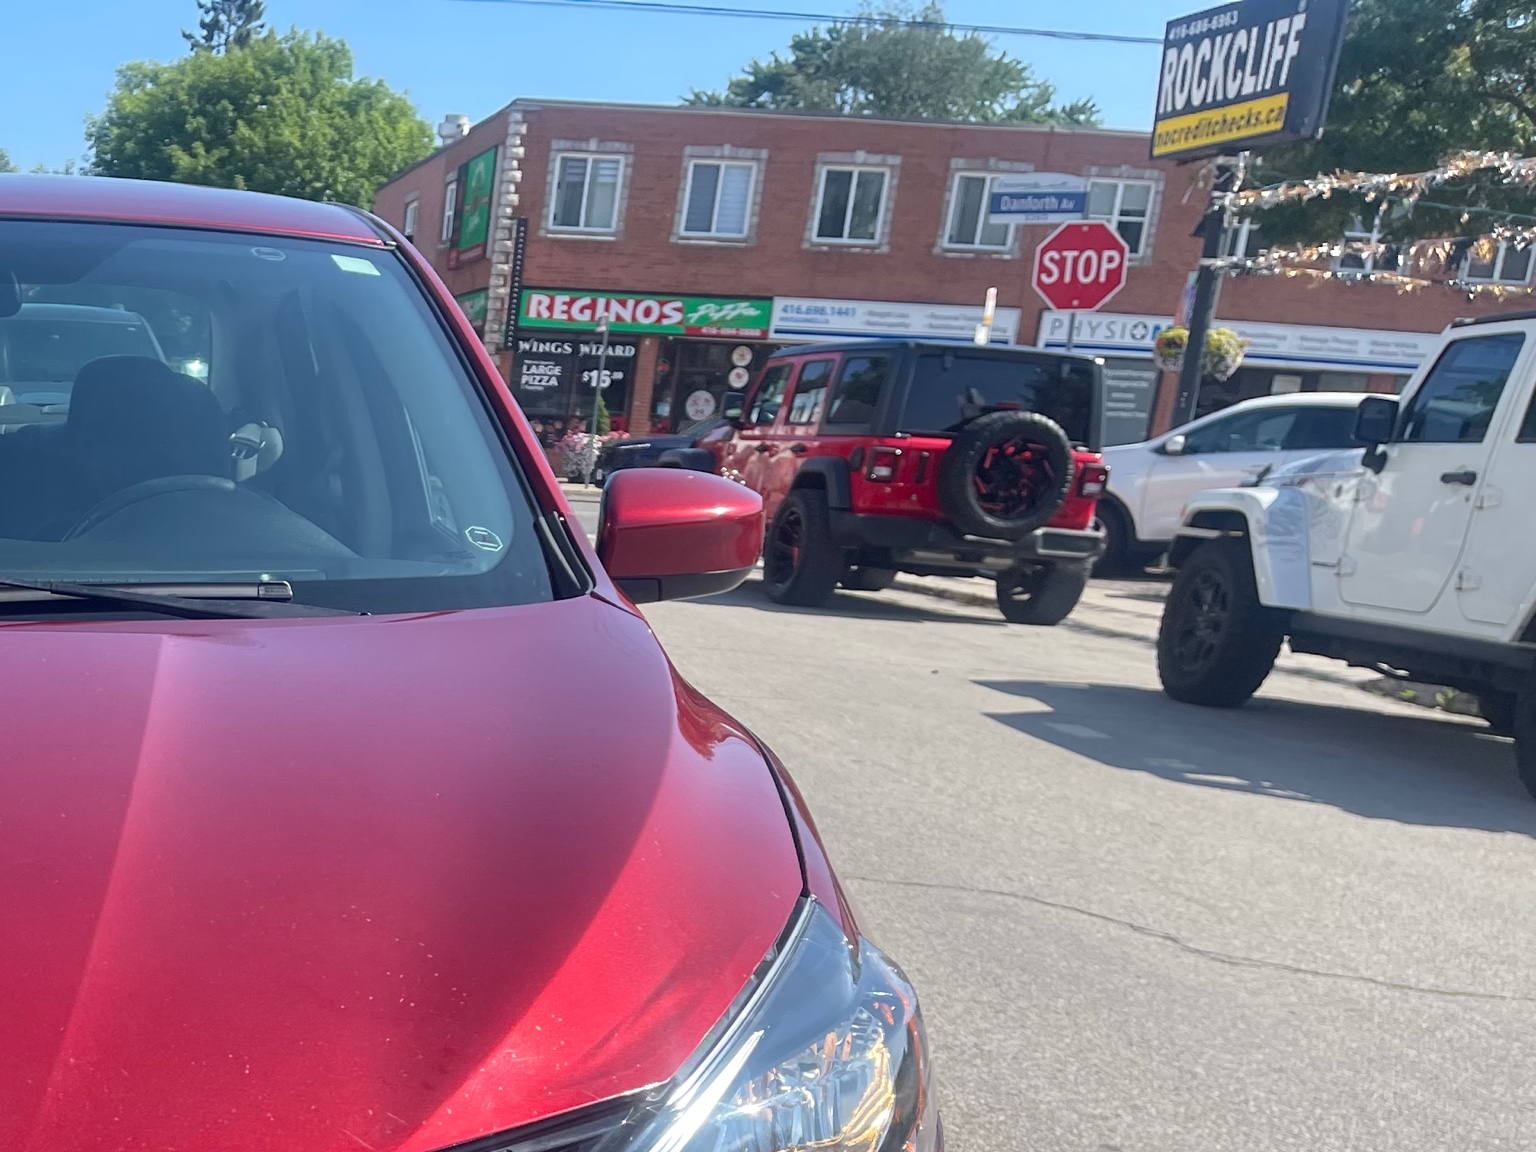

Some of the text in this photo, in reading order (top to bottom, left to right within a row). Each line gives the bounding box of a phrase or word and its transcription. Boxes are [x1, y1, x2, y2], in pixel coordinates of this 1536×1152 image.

[1158, 13, 1306, 115] ROCKCLIFF
[999, 195, 1060, 211] Danforth
[1039, 248, 1122, 285] STOP
[527, 293, 684, 326] REGINOS
[517, 338, 636, 358] WINGS WIZARD
[522, 364, 562, 376] LARGE
[520, 374, 559, 387] PIZZA
